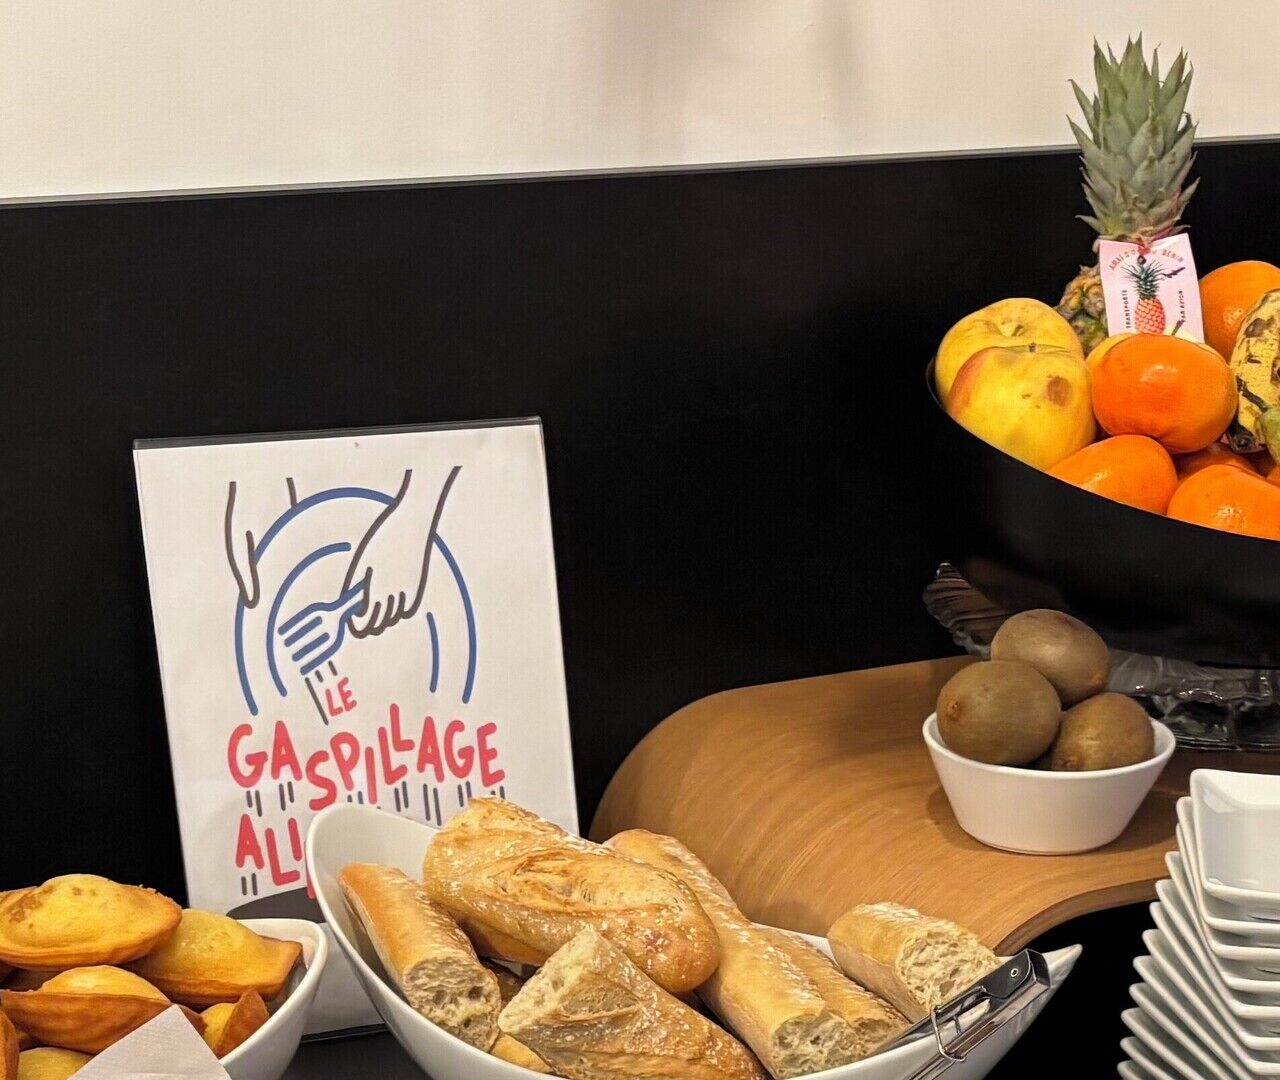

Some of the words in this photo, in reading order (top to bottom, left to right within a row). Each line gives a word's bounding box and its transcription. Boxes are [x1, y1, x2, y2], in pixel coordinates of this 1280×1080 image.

[325, 677, 357, 717] LE
[227, 703, 505, 811] GASPILLAGE
[235, 813, 317, 900] ALI
